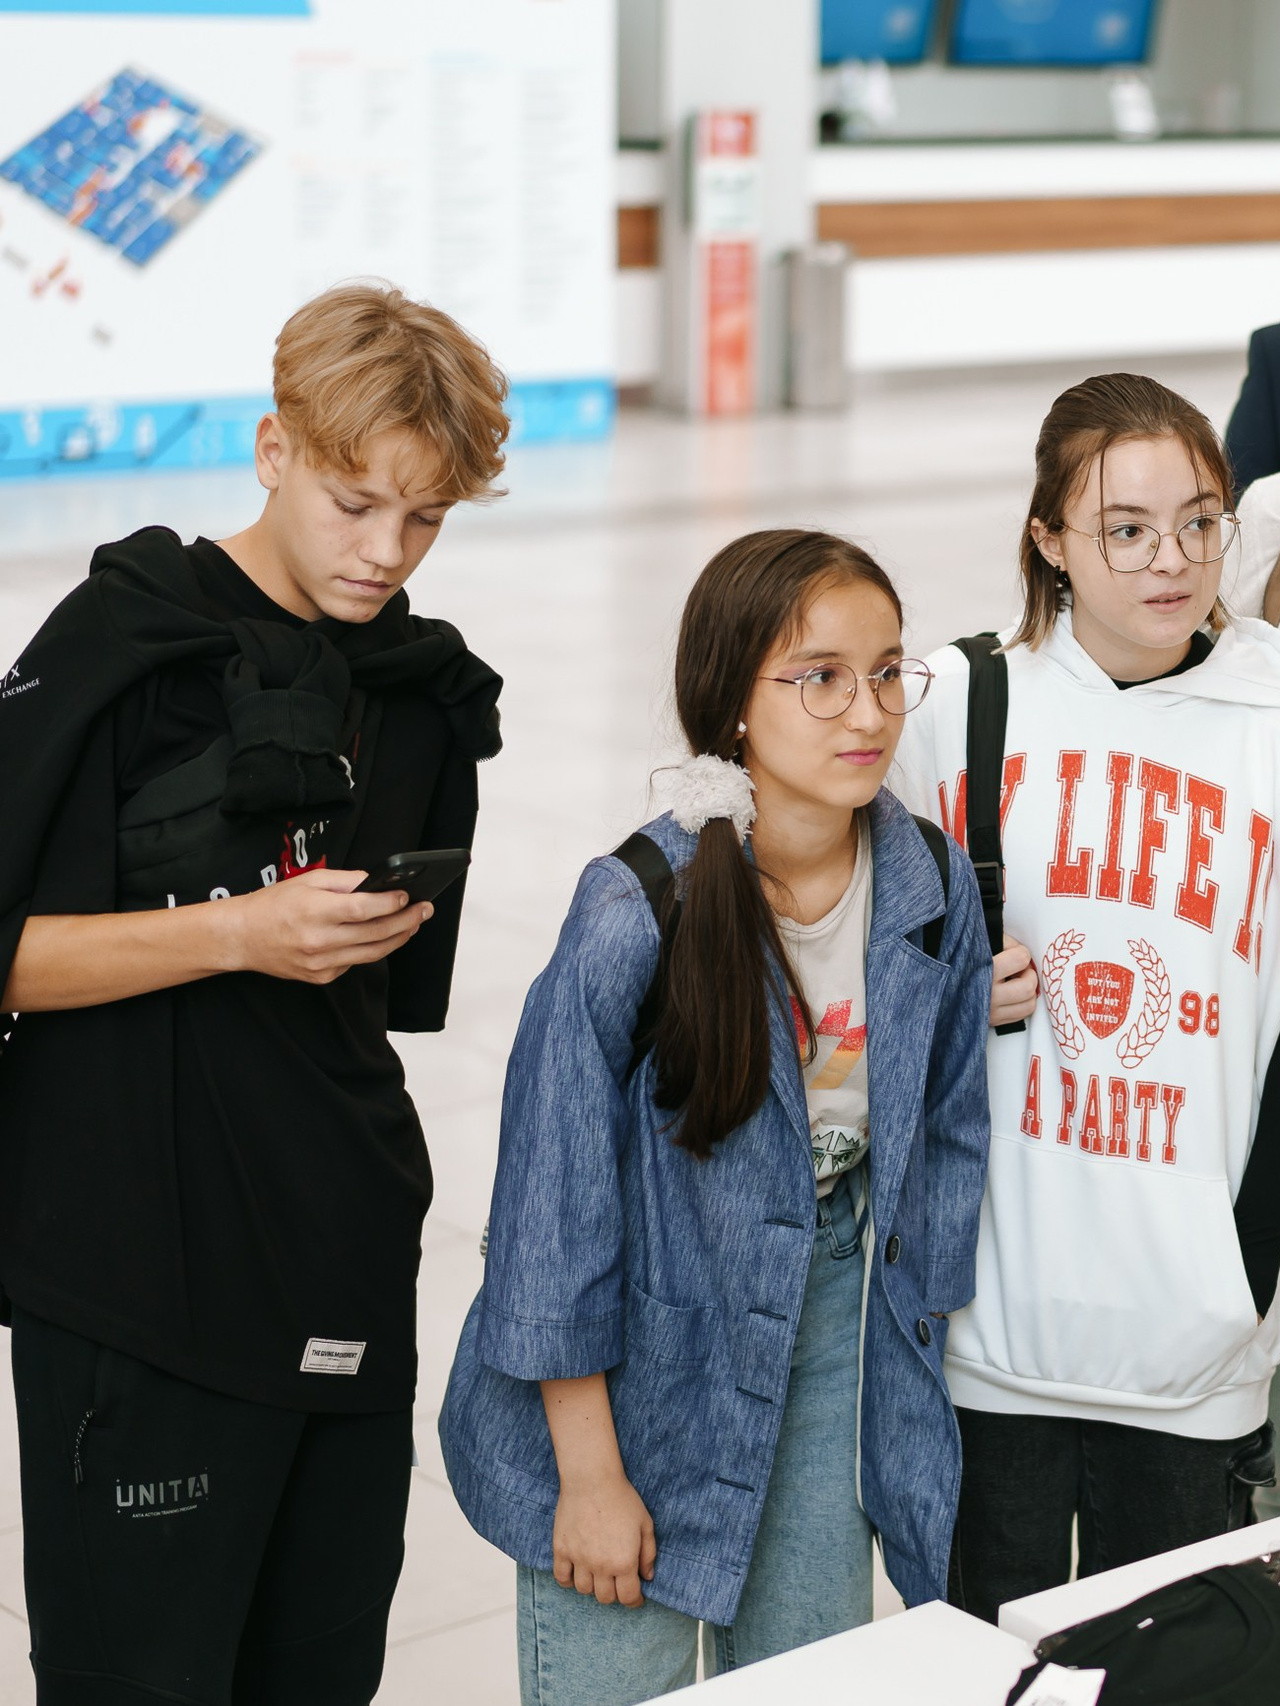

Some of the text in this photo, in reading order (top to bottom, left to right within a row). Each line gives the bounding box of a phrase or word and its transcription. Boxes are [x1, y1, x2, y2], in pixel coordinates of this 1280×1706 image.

[2, 677, 40, 698] EXCHANGE
[1045, 749, 1228, 934] LIFE
[1232, 808, 1275, 977] I
[1087, 977, 1120, 989] BUT YOU
[1087, 995, 1120, 1007] ARE NOT
[1086, 1012, 1119, 1024] INVITED
[1177, 989, 1220, 1039] 98
[1020, 1054, 1187, 1165] A PARTY
